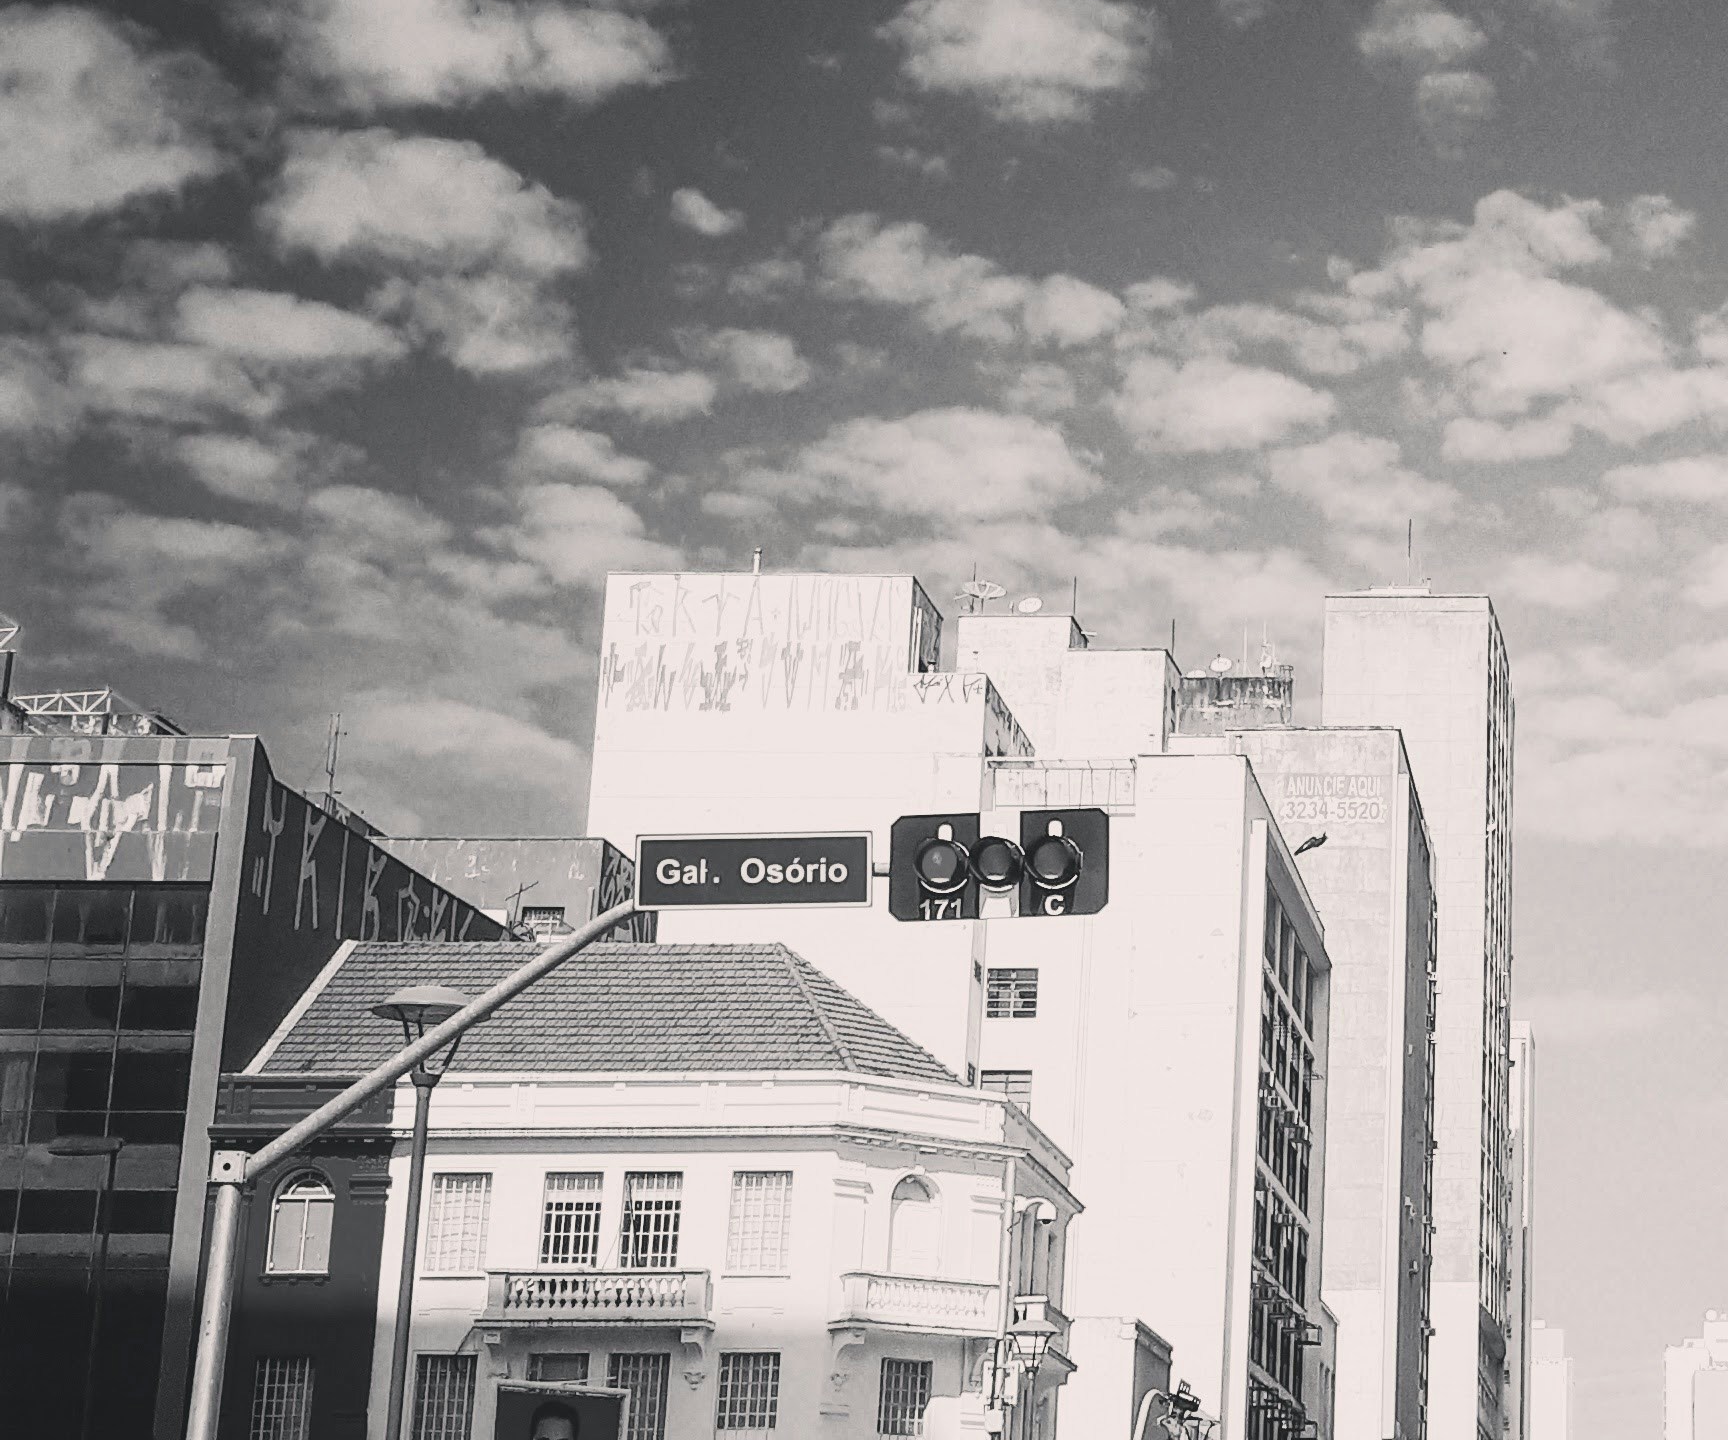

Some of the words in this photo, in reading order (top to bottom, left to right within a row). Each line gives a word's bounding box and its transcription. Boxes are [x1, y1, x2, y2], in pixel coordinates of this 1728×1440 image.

[1286, 775, 1346, 796] ANUNCIE
[1348, 775, 1381, 796] AQUI
[1285, 801, 1381, 820] 3234-5520
[655, 858, 720, 885] Gal.
[740, 857, 849, 884] Osório
[919, 897, 963, 921] 171
[1044, 894, 1065, 916] C
